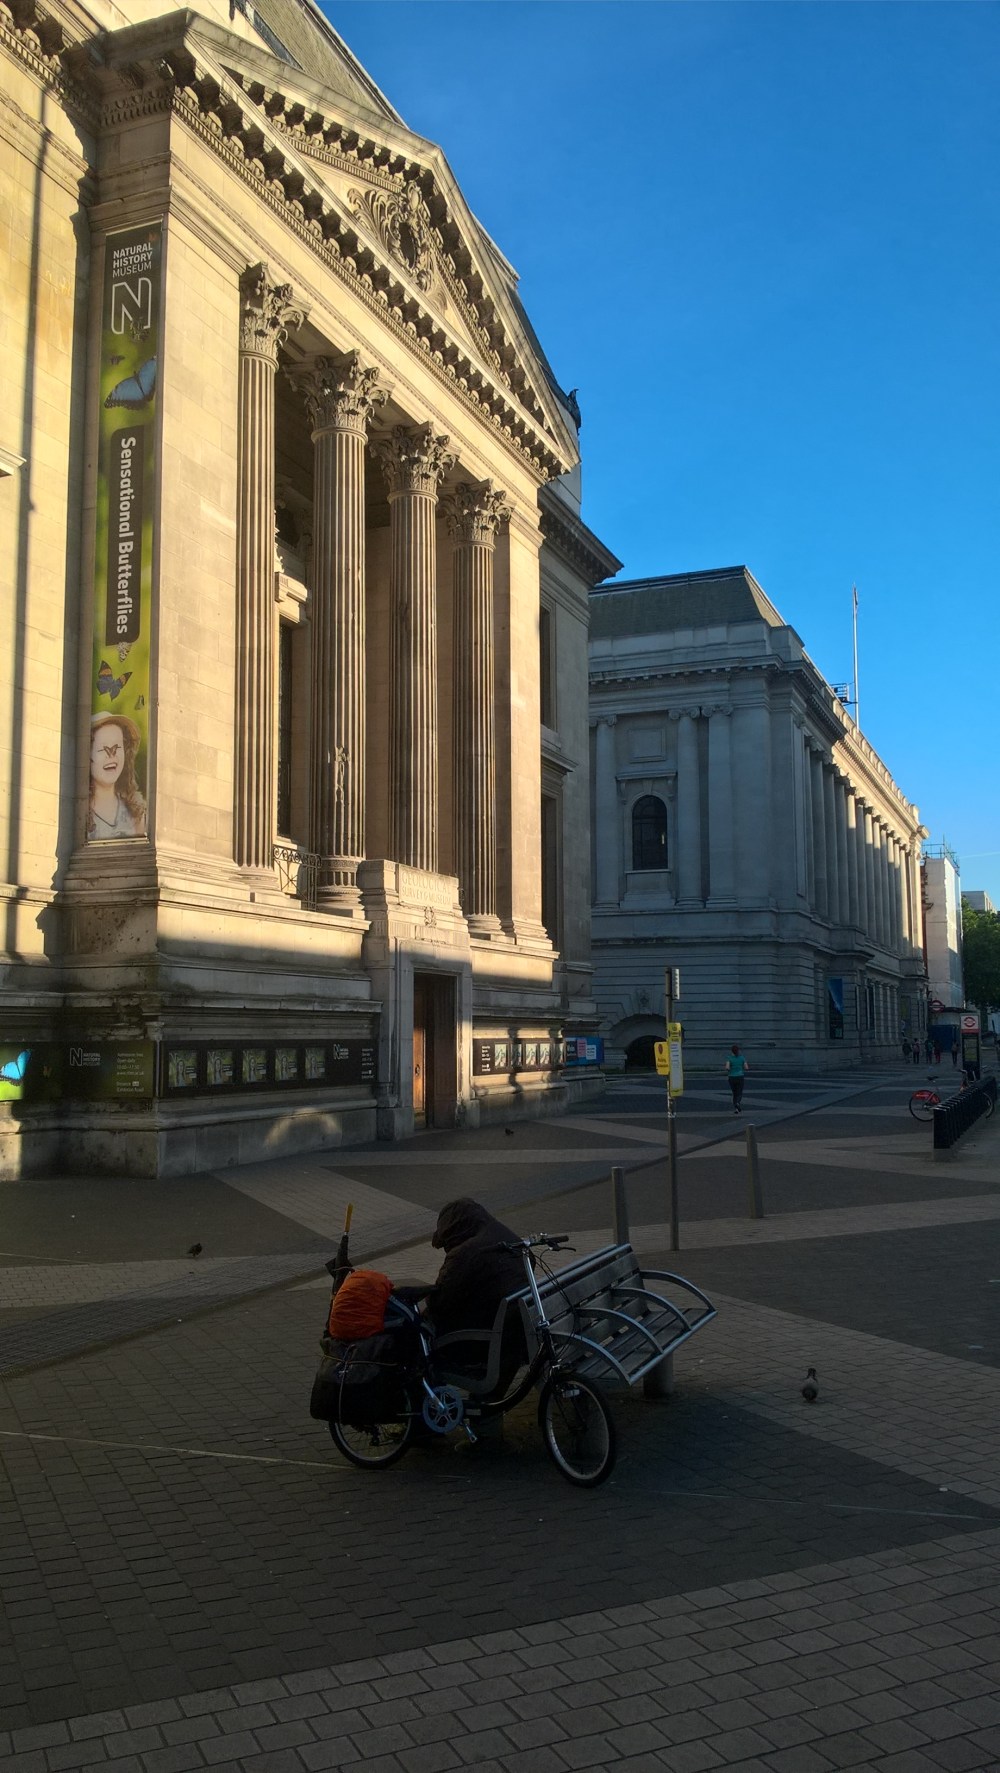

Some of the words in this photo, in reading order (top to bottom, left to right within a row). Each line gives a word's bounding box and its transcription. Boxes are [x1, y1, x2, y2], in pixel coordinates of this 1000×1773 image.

[113, 242, 153, 259] NATURAL
[113, 251, 153, 269] HISTORY
[112, 261, 152, 278] MUSEUM
[118, 436, 137, 538] Sensational
[116, 540, 134, 634] Butterflies
[402, 871, 451, 895] GEOLOGICAL
